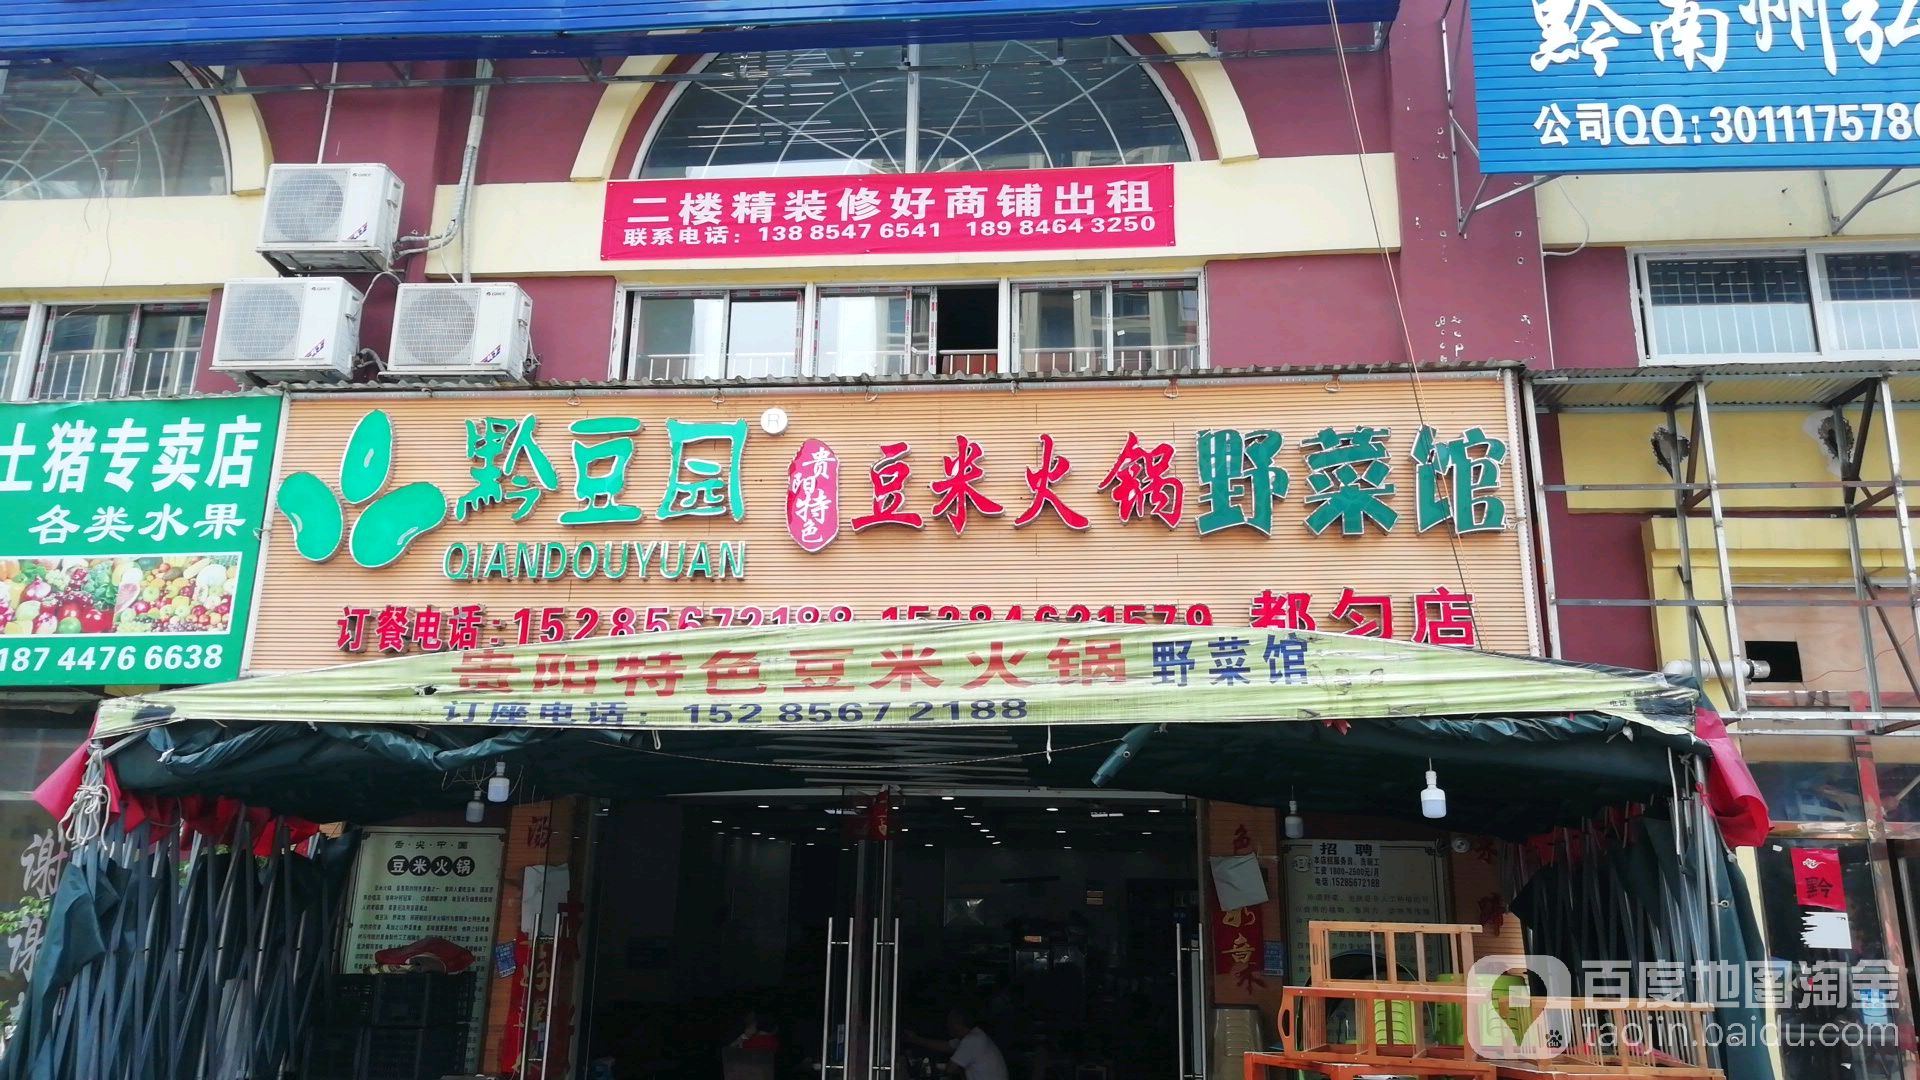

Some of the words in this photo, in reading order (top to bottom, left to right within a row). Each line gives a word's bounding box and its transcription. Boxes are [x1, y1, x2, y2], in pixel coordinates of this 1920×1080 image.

[1533, 102, 1920, 146] 公司QQ:301117578
[627, 180, 1153, 225] 二楼精装修好商铺出租
[623, 226, 740, 246] 联系电话:
[758, 225, 803, 241] 138
[810, 223, 872, 240] 8547
[880, 222, 940, 239] 6541
[966, 221, 1012, 237] 189
[1019, 218, 1083, 235] 8464
[1090, 215, 1156, 233] 3250
[0, 414, 261, 493] 土猪专卖店
[454, 413, 749, 525] 黔豆园
[791, 446, 836, 543] 贵阳特色
[851, 431, 1185, 536] 豆米火锅
[1195, 424, 1507, 538] 野菜馆
[28, 503, 246, 545] 各类水果
[443, 540, 745, 580] QIANDOUYUAN
[336, 604, 502, 653] 订餐电话:
[1249, 586, 1477, 649] 都匀店
[0, 646, 50, 671] 187
[57, 645, 136, 671] 4476
[144, 644, 223, 670] 6638
[451, 637, 1126, 697] 贵阳特色豆米火锅
[1152, 633, 1307, 686] 野菜馆
[443, 701, 647, 725] 订座电话:
[684, 702, 762, 724] 152
[778, 701, 891, 724] 8567
[908, 699, 1028, 722] 2188
[389, 857, 472, 875] 豆米火锅
[1319, 842, 1373, 857] 招聘
[6, 829, 68, 1014] 谢谢
